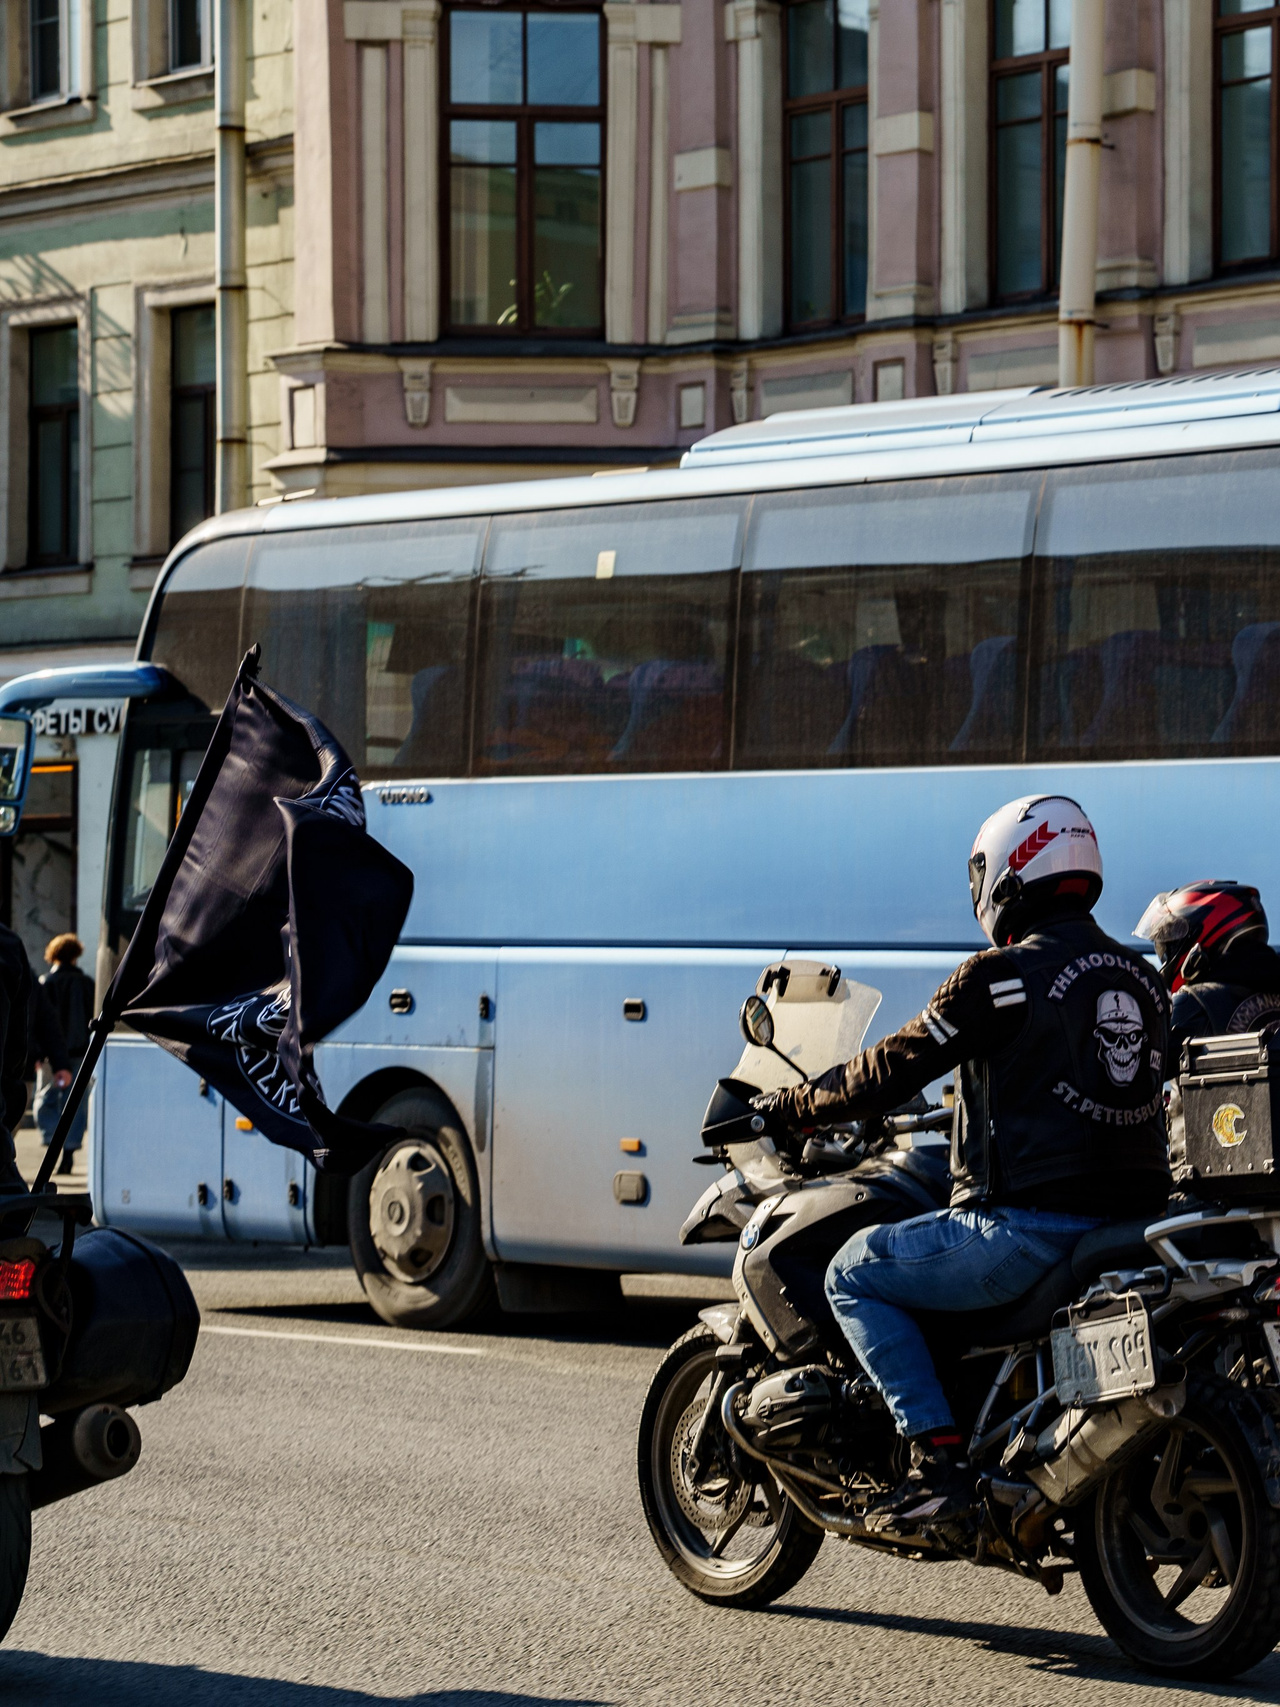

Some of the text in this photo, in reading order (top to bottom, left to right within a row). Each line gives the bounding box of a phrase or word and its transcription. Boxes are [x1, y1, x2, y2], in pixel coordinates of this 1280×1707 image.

[20, 706, 124, 735] ФЕТЫ СУ
[1047, 952, 1165, 1014] THE HOOLIGANS
[1080, 1092, 1162, 1127] PETERSBU
